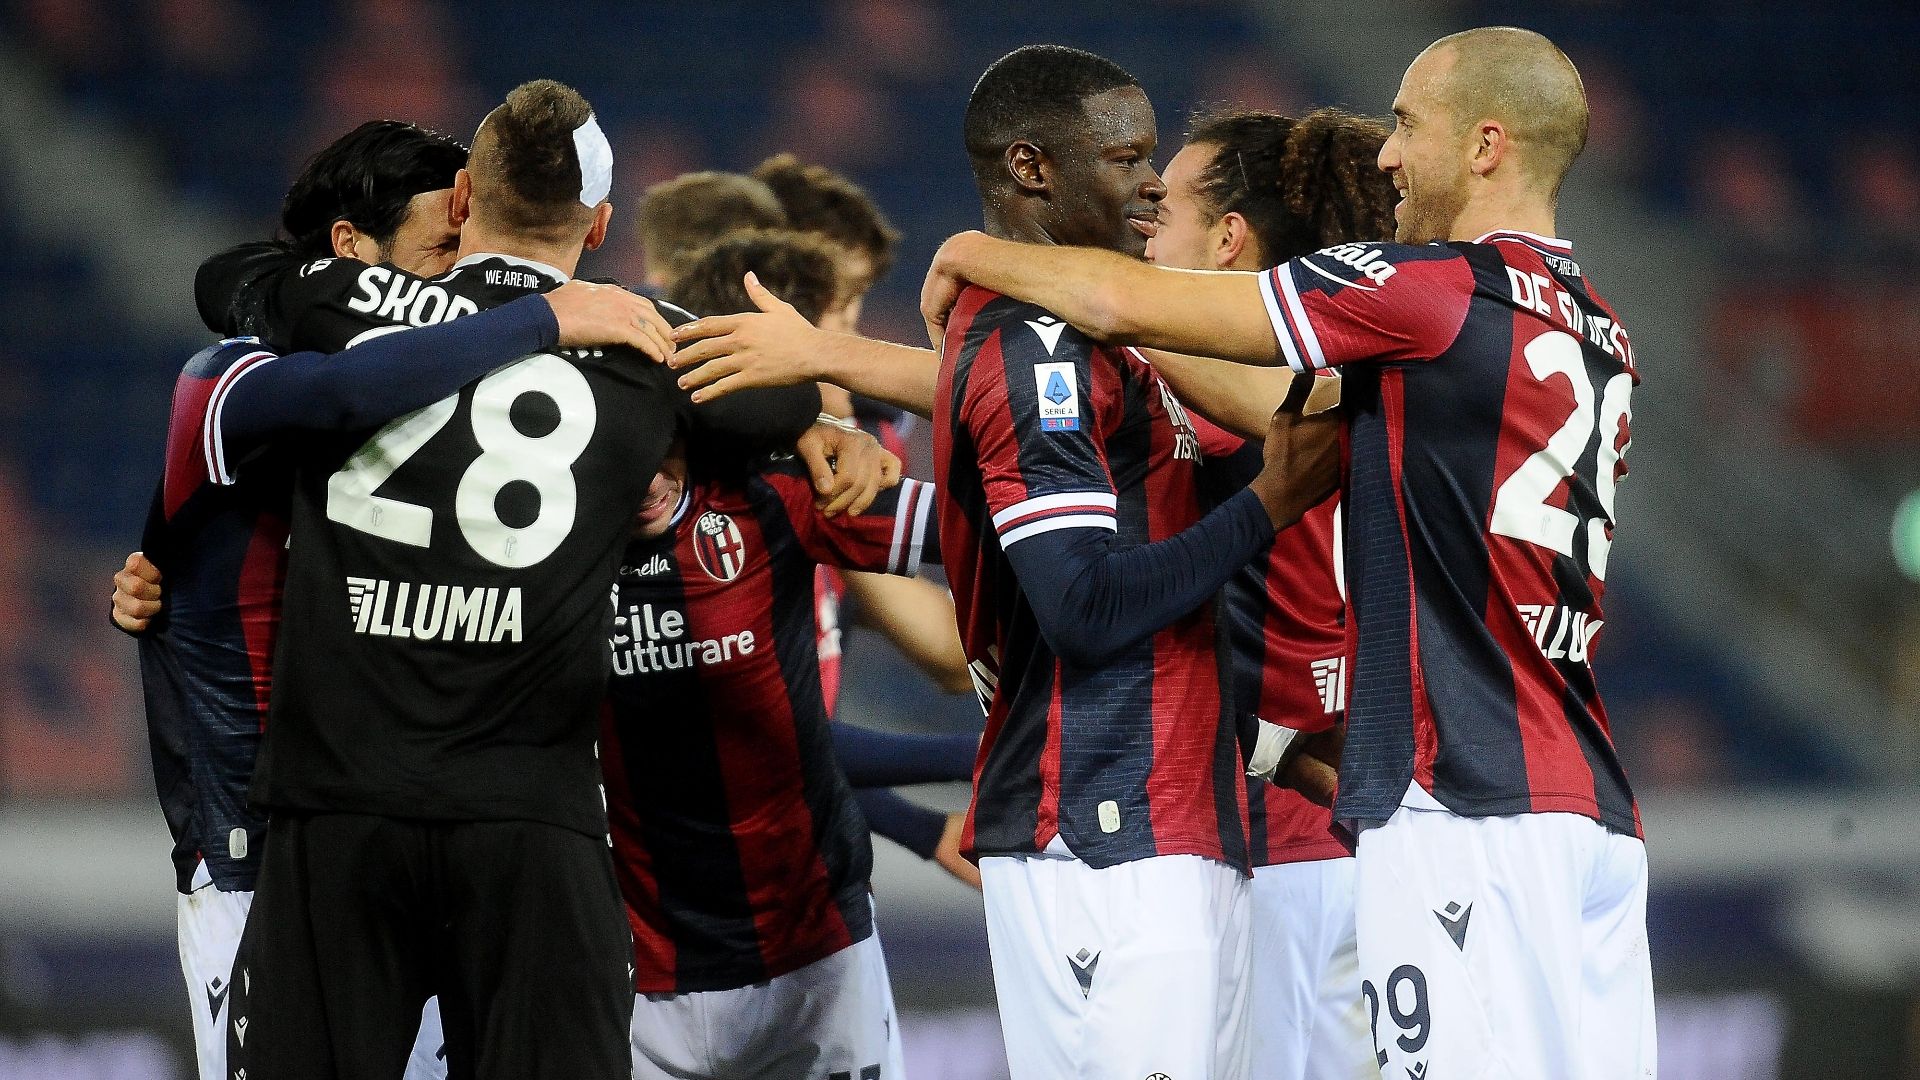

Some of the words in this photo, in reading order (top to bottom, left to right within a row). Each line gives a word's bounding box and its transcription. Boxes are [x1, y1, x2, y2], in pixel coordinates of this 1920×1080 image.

[485, 269, 503, 285] WE
[502, 270, 523, 287] ARE
[523, 273, 540, 289] ONE
[1545, 256, 1559, 269] WE
[1558, 260, 1571, 276] ARE
[1504, 265, 1552, 318] DE
[1044, 408, 1066, 416] SERIE
[326, 326, 597, 568] 28
[700, 513, 726, 532] BFC
[346, 577, 523, 643] ILLUMIA
[612, 630, 756, 676] utturare
